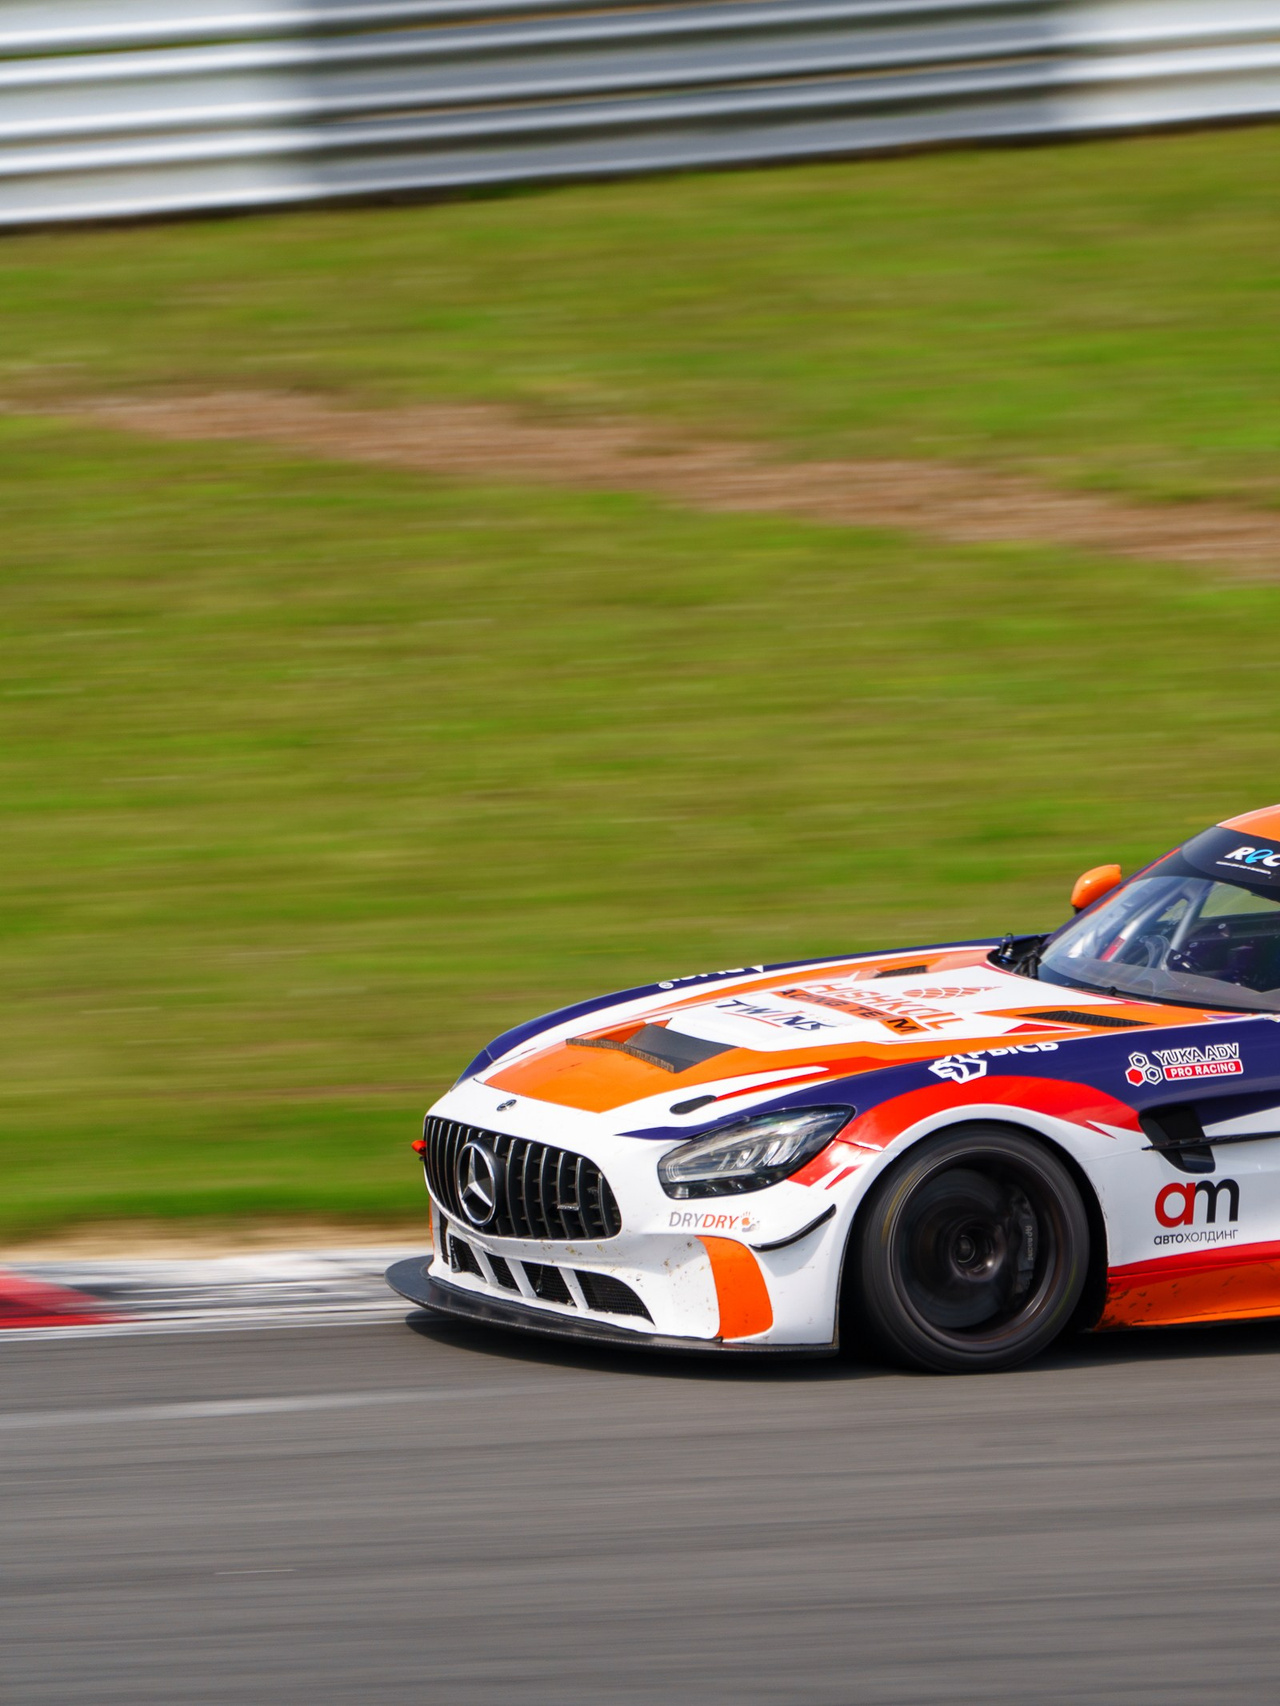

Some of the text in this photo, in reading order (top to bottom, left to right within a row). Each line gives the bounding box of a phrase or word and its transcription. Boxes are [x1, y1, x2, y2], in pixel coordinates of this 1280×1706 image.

[803, 983, 965, 1030] HISHKOIL
[1170, 1062, 1236, 1078] PRO RACING
[669, 1211, 739, 1230] DRYDRY
